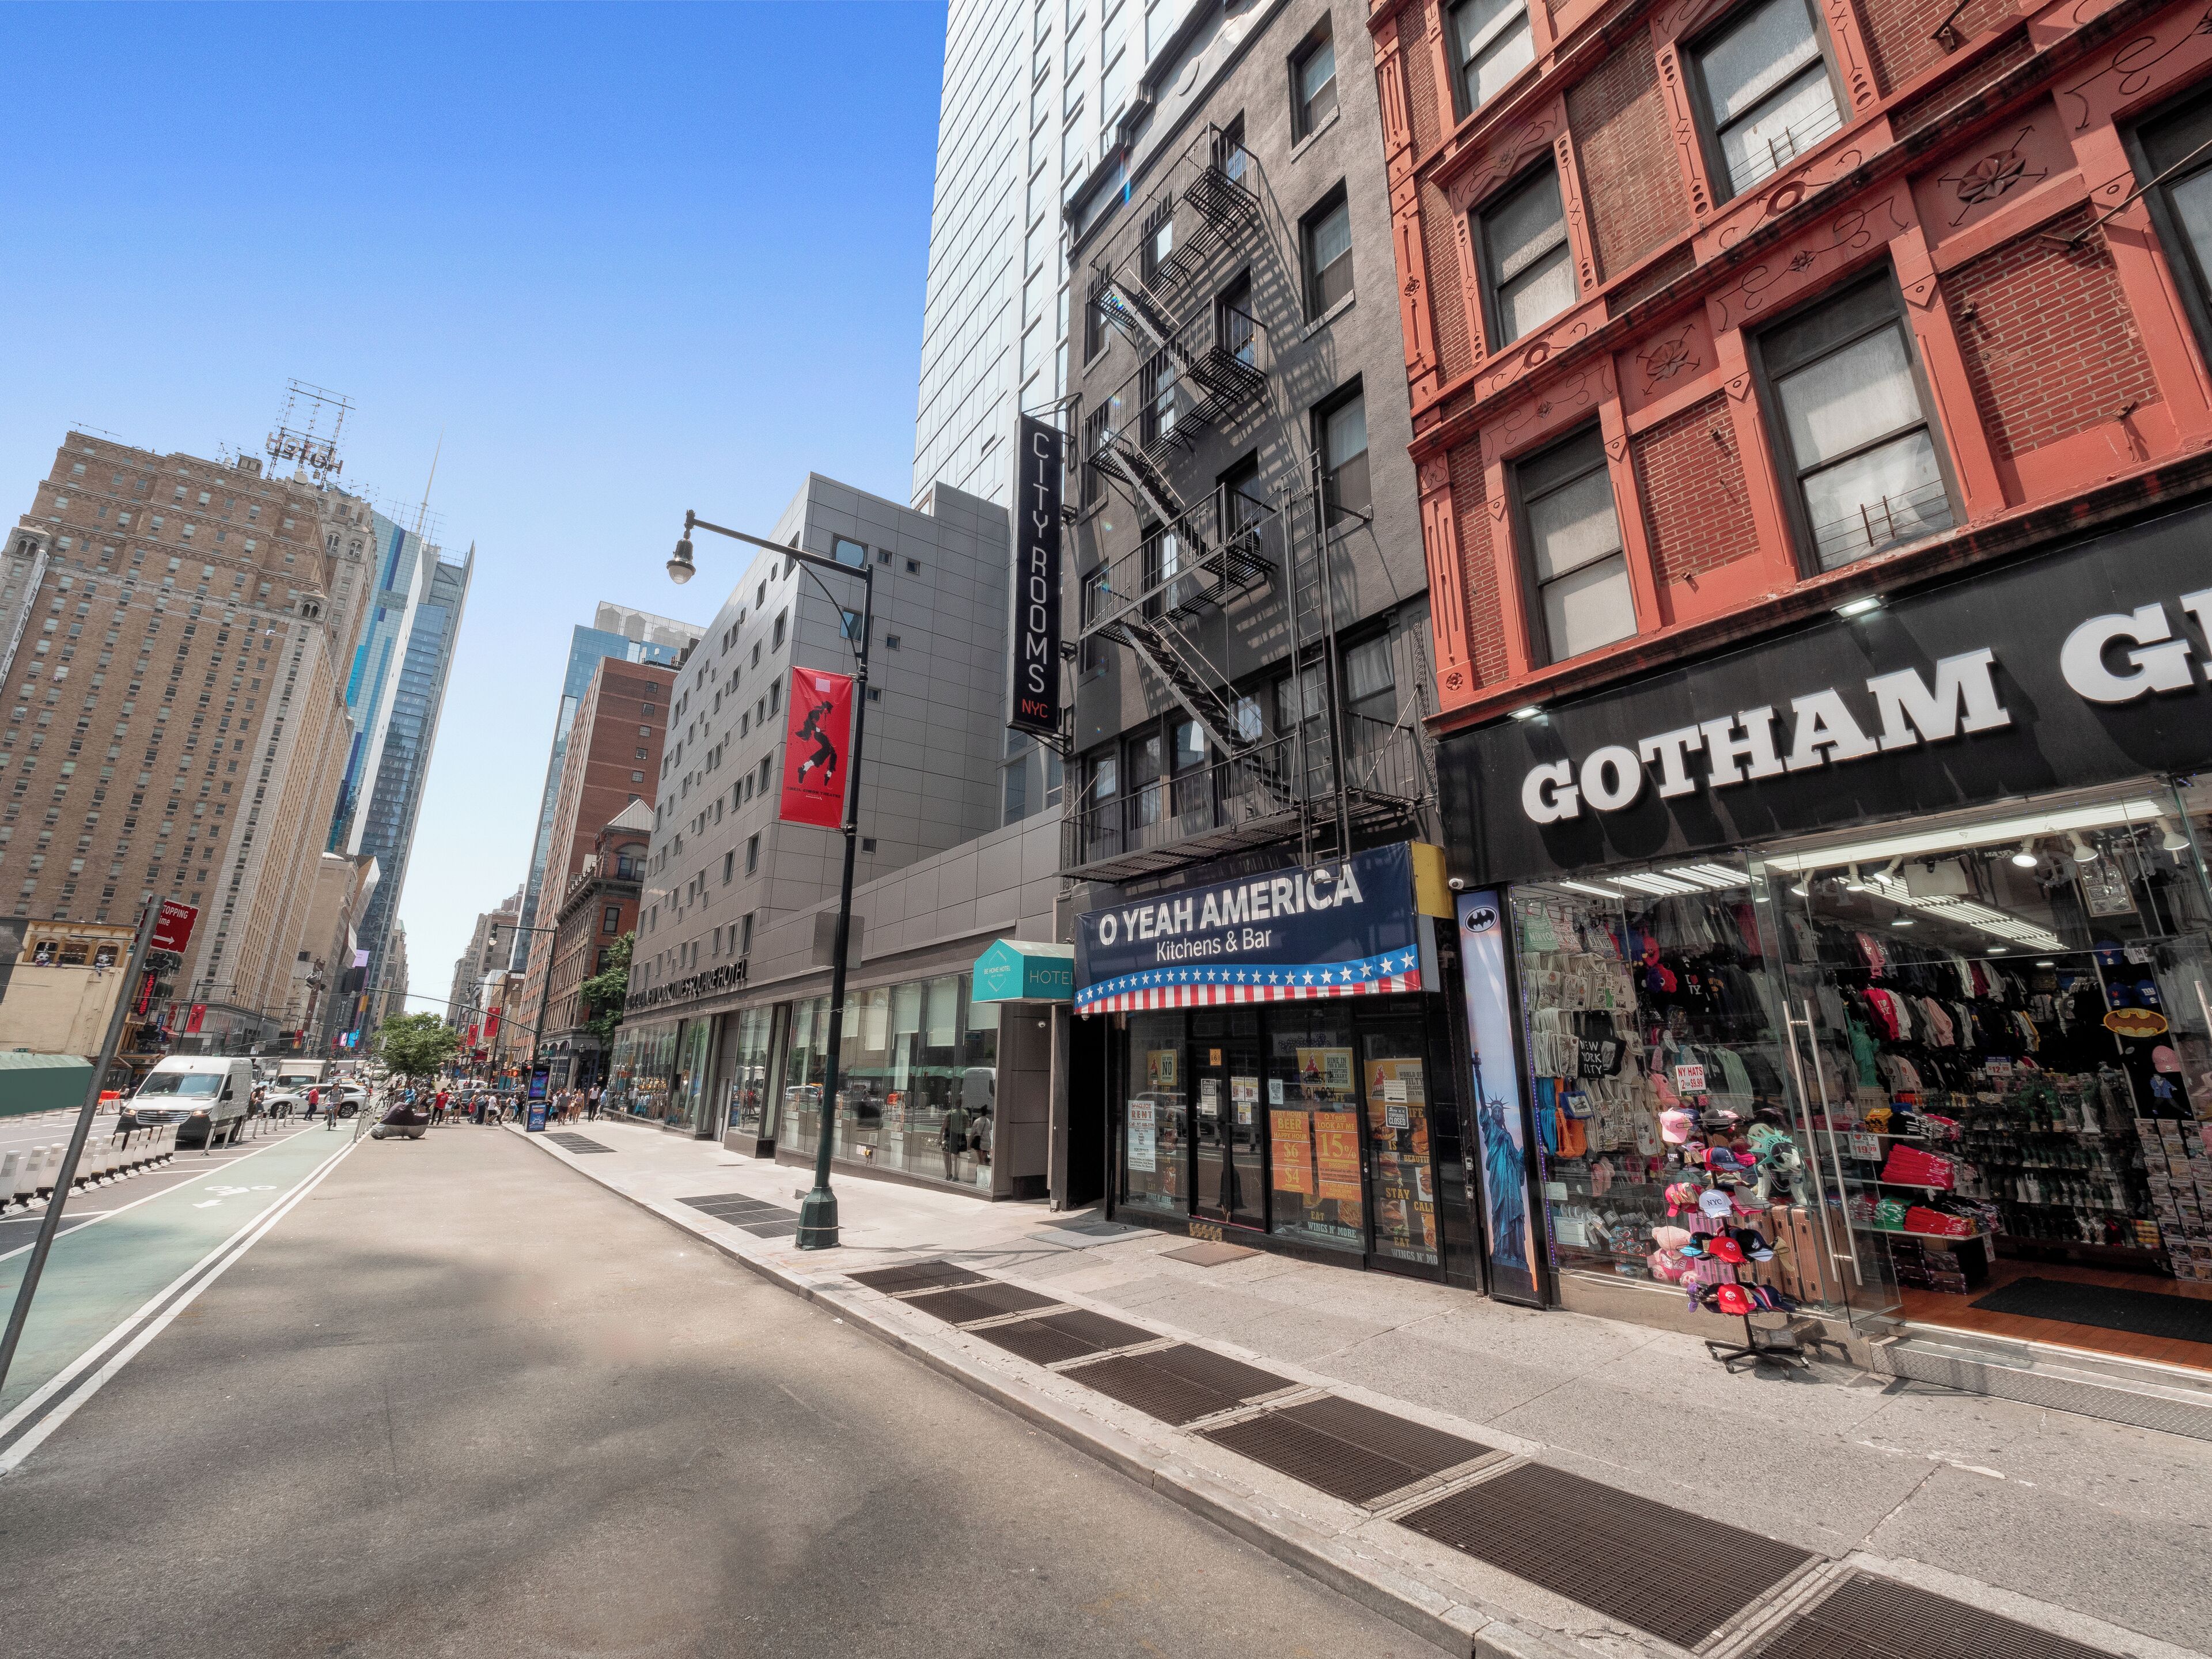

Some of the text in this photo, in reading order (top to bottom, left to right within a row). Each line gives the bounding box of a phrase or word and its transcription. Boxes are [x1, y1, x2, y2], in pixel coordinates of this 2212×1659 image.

[1033, 432, 1050, 538] CITY
[1025, 546, 1047, 693] ROOMS
[1022, 698, 1048, 718] NYC
[1521, 647, 2011, 824] GOTHAM
[1099, 863, 1364, 946] O YEAH AMERICA
[162, 905, 189, 919] TOPPING
[158, 915, 171, 926] ime
[1156, 927, 1272, 961] Kitchens & Bar
[717, 959, 748, 987] HOTEL
[1162, 1061, 1172, 1076] NO
[1677, 1066, 1703, 1077] NY HATS
[1681, 1080, 1685, 1089] 2
[1690, 1078, 1703, 1088] $9.99
[1131, 1111, 1152, 1119] RENT
[1409, 1108, 1423, 1118] IFE
[1278, 1118, 1302, 1130] BEER
[1389, 1118, 1406, 1126] CLOSED
[1283, 1142, 1299, 1157] $6
[1388, 1141, 1397, 1150] IS
[1285, 1167, 1300, 1183] $4
[1386, 1188, 1410, 1200] STAY
[1310, 1211, 1325, 1221] EAT
[1308, 1222, 1357, 1238] WINGS N' MORE
[1394, 1237, 1410, 1248] EAT
[1391, 1248, 1415, 1261] WINGS
[1416, 1252, 1425, 1263] N'
